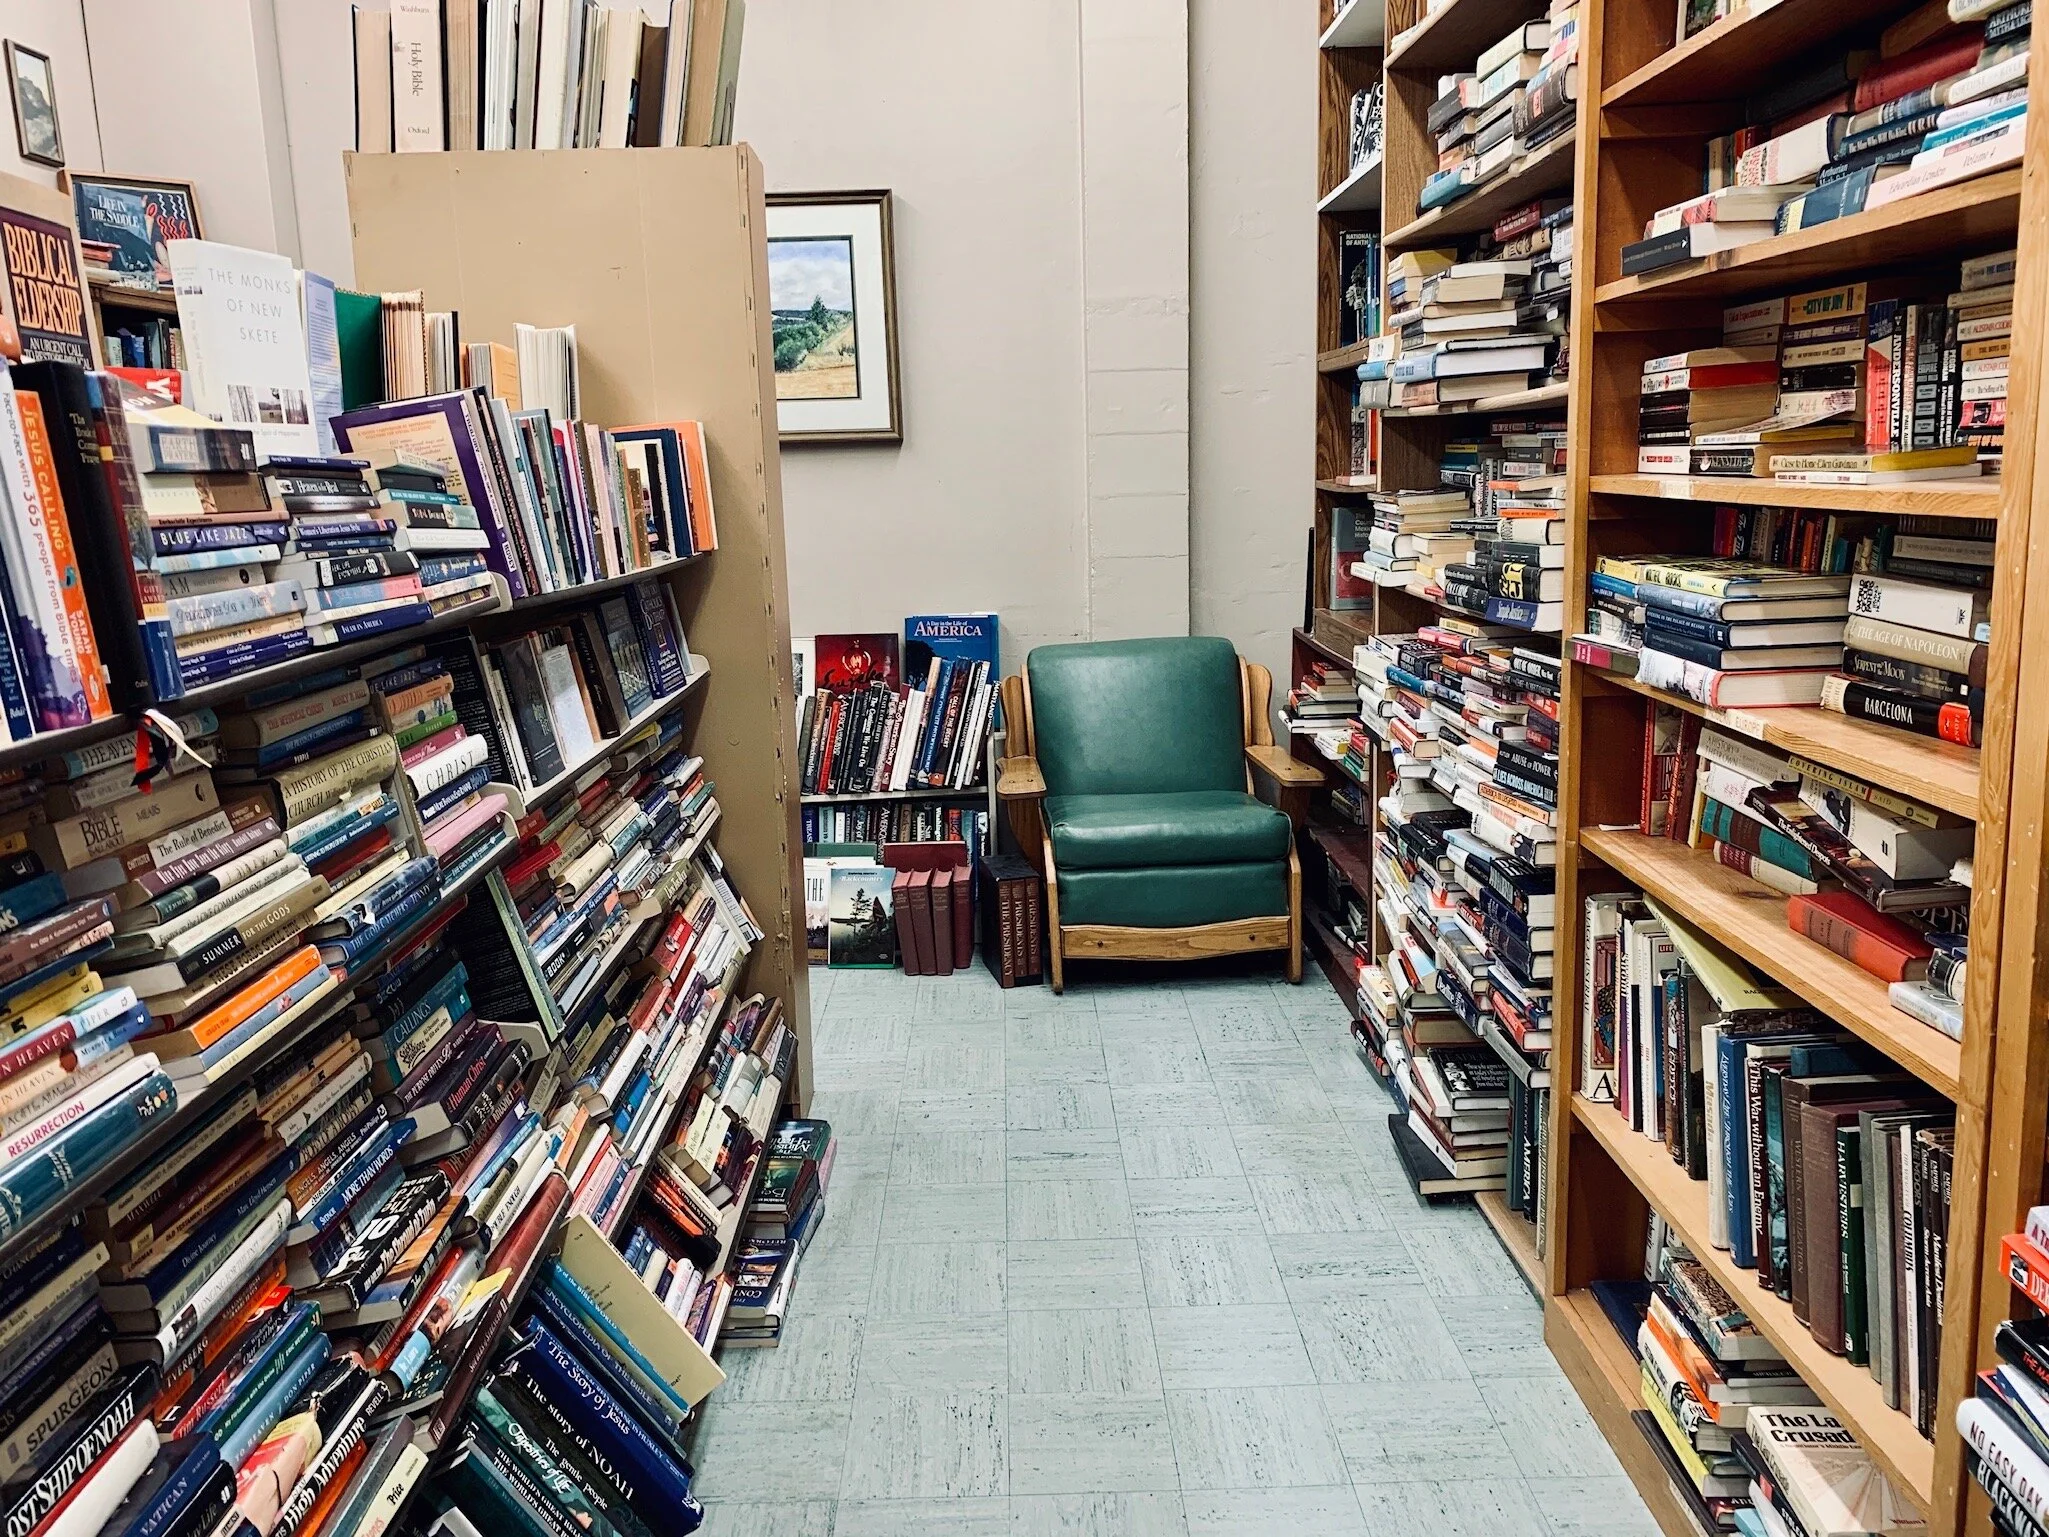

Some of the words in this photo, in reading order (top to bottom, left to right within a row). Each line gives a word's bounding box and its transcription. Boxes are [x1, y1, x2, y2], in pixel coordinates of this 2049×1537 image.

[409, 42, 421, 67] Holy
[411, 70, 421, 96] Bible
[407, 126, 429, 135] Oxford
[90, 208, 107, 220] THE
[98, 195, 115, 210] LIFE
[3, 222, 79, 288] BIBLICAL
[208, 268, 233, 285] THE
[241, 274, 291, 294] MONKS
[12, 275, 83, 337] ELDERSHIP
[226, 299, 243, 312] OF
[250, 302, 282, 318] NEW
[38, 340, 65, 353] URGENT
[66, 343, 83, 357] CALL
[239, 328, 278, 343] SKETE
[1891, 334, 1902, 439] ANDERSONVILLE
[22, 406, 44, 466] JESUS
[19, 459, 31, 487] with
[23, 491, 42, 527] 365
[34, 532, 52, 576] people
[160, 532, 191, 545] BLUE
[194, 530, 219, 543] LIKE
[224, 528, 248, 540] JAZZ
[48, 578, 60, 609] from
[55, 615, 68, 644] Bible
[69, 612, 84, 654] YOUNG
[76, 610, 92, 654] SARAH
[914, 621, 982, 637] AMERICA
[1857, 626, 1872, 639] THE
[1873, 630, 1890, 643] AGE
[1891, 635, 1903, 646] OF
[1904, 636, 1960, 660] NAPOLEON
[64, 649, 78, 683] times
[1735, 717, 1761, 733] EUROPE
[1864, 697, 1913, 724] BARCELONA
[283, 786, 292, 798] A
[292, 771, 326, 795] HISTORY
[327, 765, 340, 780] OF
[342, 759, 356, 774] THE
[356, 741, 394, 766] CHRISTIAN
[426, 751, 475, 791] CHRIST
[1497, 768, 1507, 783] LIES
[1507, 773, 1524, 789] ACROSS
[1524, 780, 1544, 796] AMERICA
[1511, 754, 1527, 768] ABUSE
[1532, 761, 1551, 777] POWER
[1790, 757, 1834, 781] COVERING
[1838, 775, 1867, 795] ISLAM
[288, 794, 323, 819] CHURCH
[1873, 794, 1892, 806] SAID
[79, 816, 122, 846] BIBLE
[157, 844, 173, 857] The
[173, 837, 189, 850] Rule
[198, 820, 227, 839] Benedict
[1778, 818, 1787, 830] The
[1785, 824, 1813, 852] Enlightened
[1811, 845, 1831, 865] Despots
[806, 878, 825, 902] THE
[202, 935, 242, 965] SUMMER
[242, 928, 255, 940] FOR
[255, 920, 268, 932] THE
[267, 904, 291, 923] GODS
[263, 933, 284, 951] STILL
[350, 935, 365, 951] THE
[393, 1000, 431, 1044] CALLINGS
[16, 1029, 70, 1066] HEAVEN
[15, 1070, 54, 1096] HEAVEN
[450, 1076, 472, 1111] Human
[468, 1056, 487, 1083] Christ
[1592, 1072, 1615, 1100] A
[1750, 1064, 1761, 1096] This
[1750, 1097, 1761, 1119] War
[8, 1102, 85, 1157] RESURRECTION
[1751, 1118, 1762, 1161] without
[341, 1181, 361, 1204] MORE
[360, 1165, 377, 1191] THAN
[375, 1145, 394, 1173] WORDS
[1522, 1135, 1532, 1200] AMERICA
[1755, 1180, 1764, 1235] Enemy
[1837, 1140, 1849, 1239] HARVESTERS
[1903, 1209, 1915, 1272] COLUMBUS
[165, 1338, 209, 1388] TVERBERG
[544, 1286, 601, 1351] ENCYCLOPEDIA
[600, 1348, 612, 1361] OF
[613, 1361, 631, 1379] THE
[629, 1379, 653, 1405] BIBLE
[284, 1388, 298, 1404] DON
[298, 1363, 316, 1387] PIPER
[547, 1340, 569, 1367] The
[567, 1363, 595, 1398] Story
[593, 1391, 608, 1411] of
[603, 1400, 631, 1435] Jesus
[26, 1356, 115, 1452] SPURGEON
[1761, 1413, 1809, 1427] The
[35, 1470, 77, 1513] SHIP
[76, 1443, 97, 1476] OF
[96, 1392, 136, 1453] NOAH
[526, 1373, 548, 1405] The
[547, 1404, 575, 1434] story
[575, 1434, 591, 1448] of
[588, 1446, 635, 1501] NOAH
[496, 1448, 514, 1467] THE
[539, 1492, 564, 1518] GREAT
[544, 1436, 561, 1457] The
[558, 1457, 583, 1482] gentle
[582, 1481, 609, 1510] people
[1970, 1421, 1986, 1449] NO
[1988, 1442, 2018, 1485] EASY
[2019, 1477, 2043, 1514] DAY
[140, 1477, 188, 1536] VATICAN
[492, 1456, 509, 1474] THE
[536, 1503, 562, 1534] GREAT
